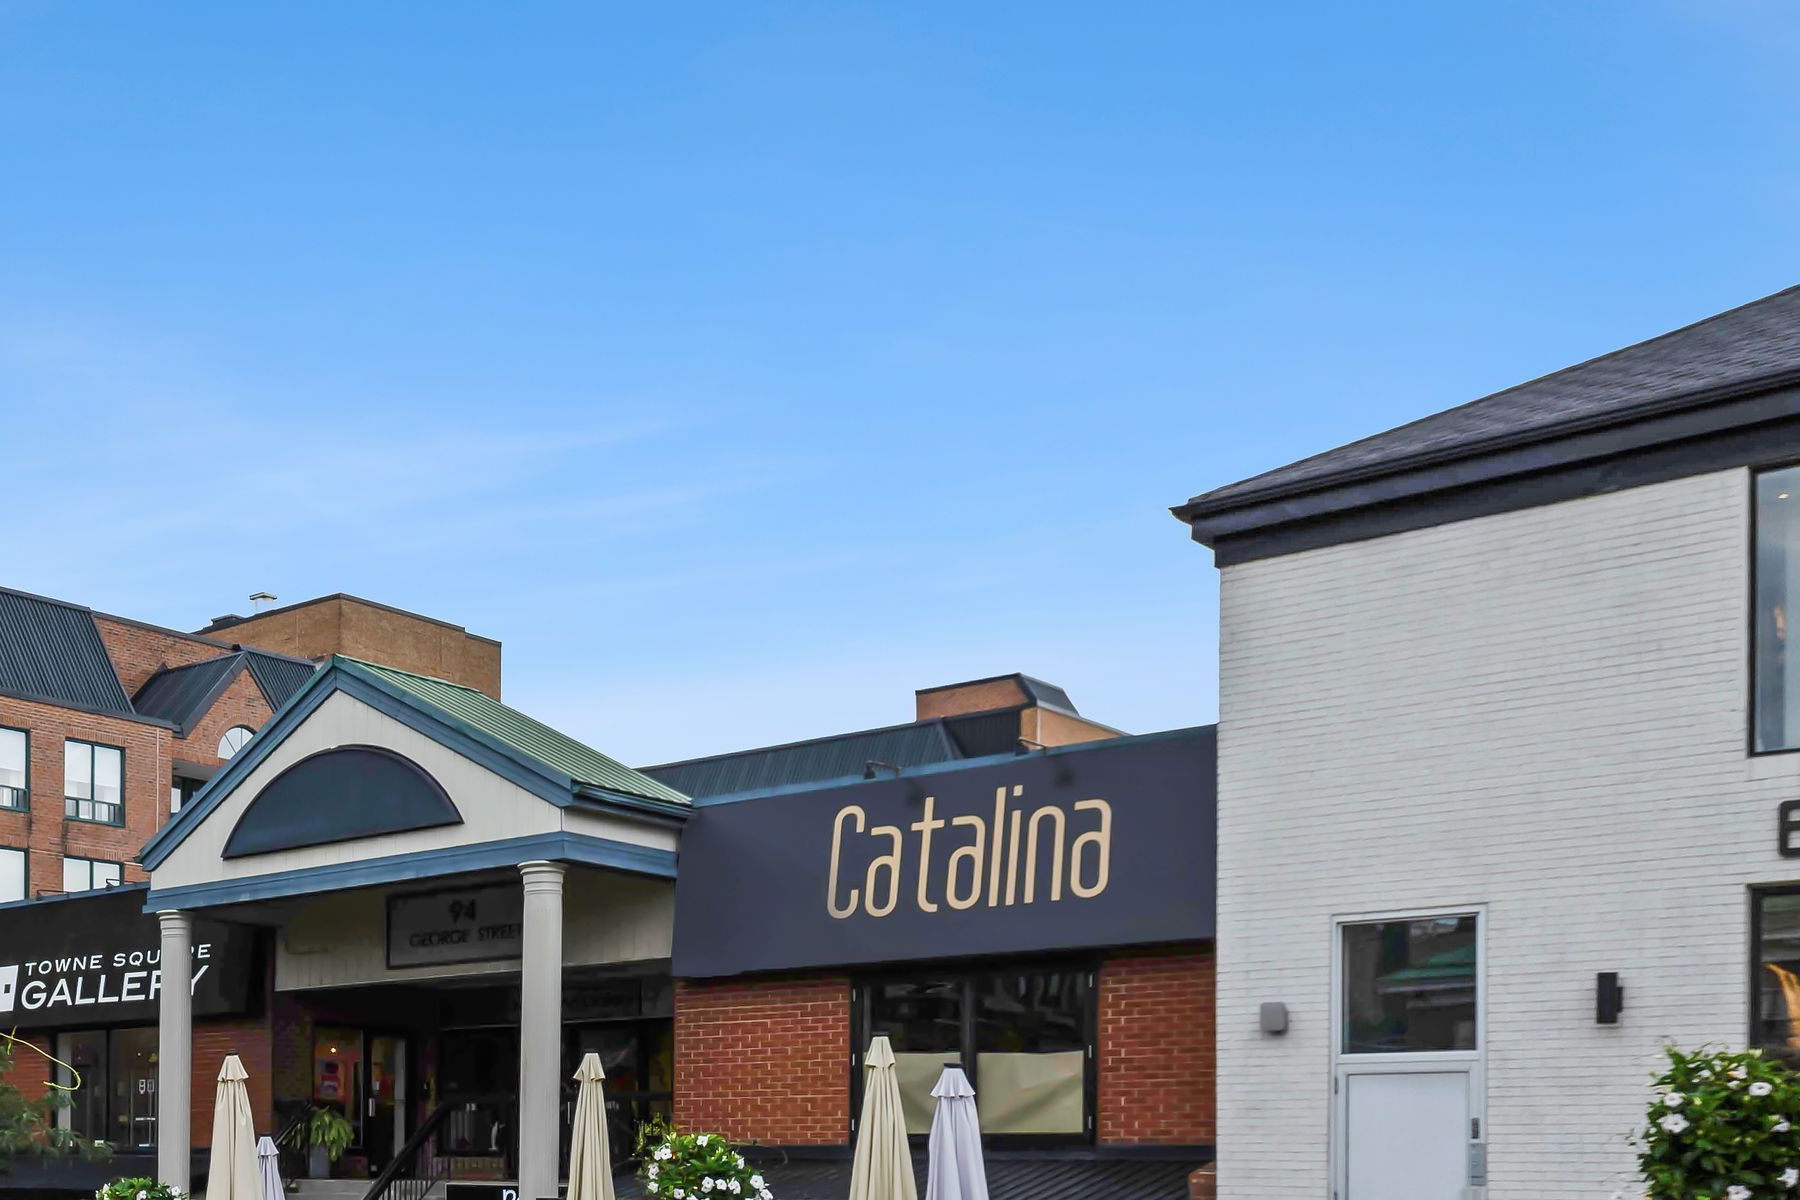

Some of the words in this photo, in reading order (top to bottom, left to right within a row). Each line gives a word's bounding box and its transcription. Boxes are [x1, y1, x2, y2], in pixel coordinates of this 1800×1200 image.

[827, 784, 1112, 919] Catalina
[448, 898, 477, 924] 94
[409, 929, 470, 946] GEORGE
[25, 954, 103, 976] TOWNE
[112, 943, 212, 968] SQUE
